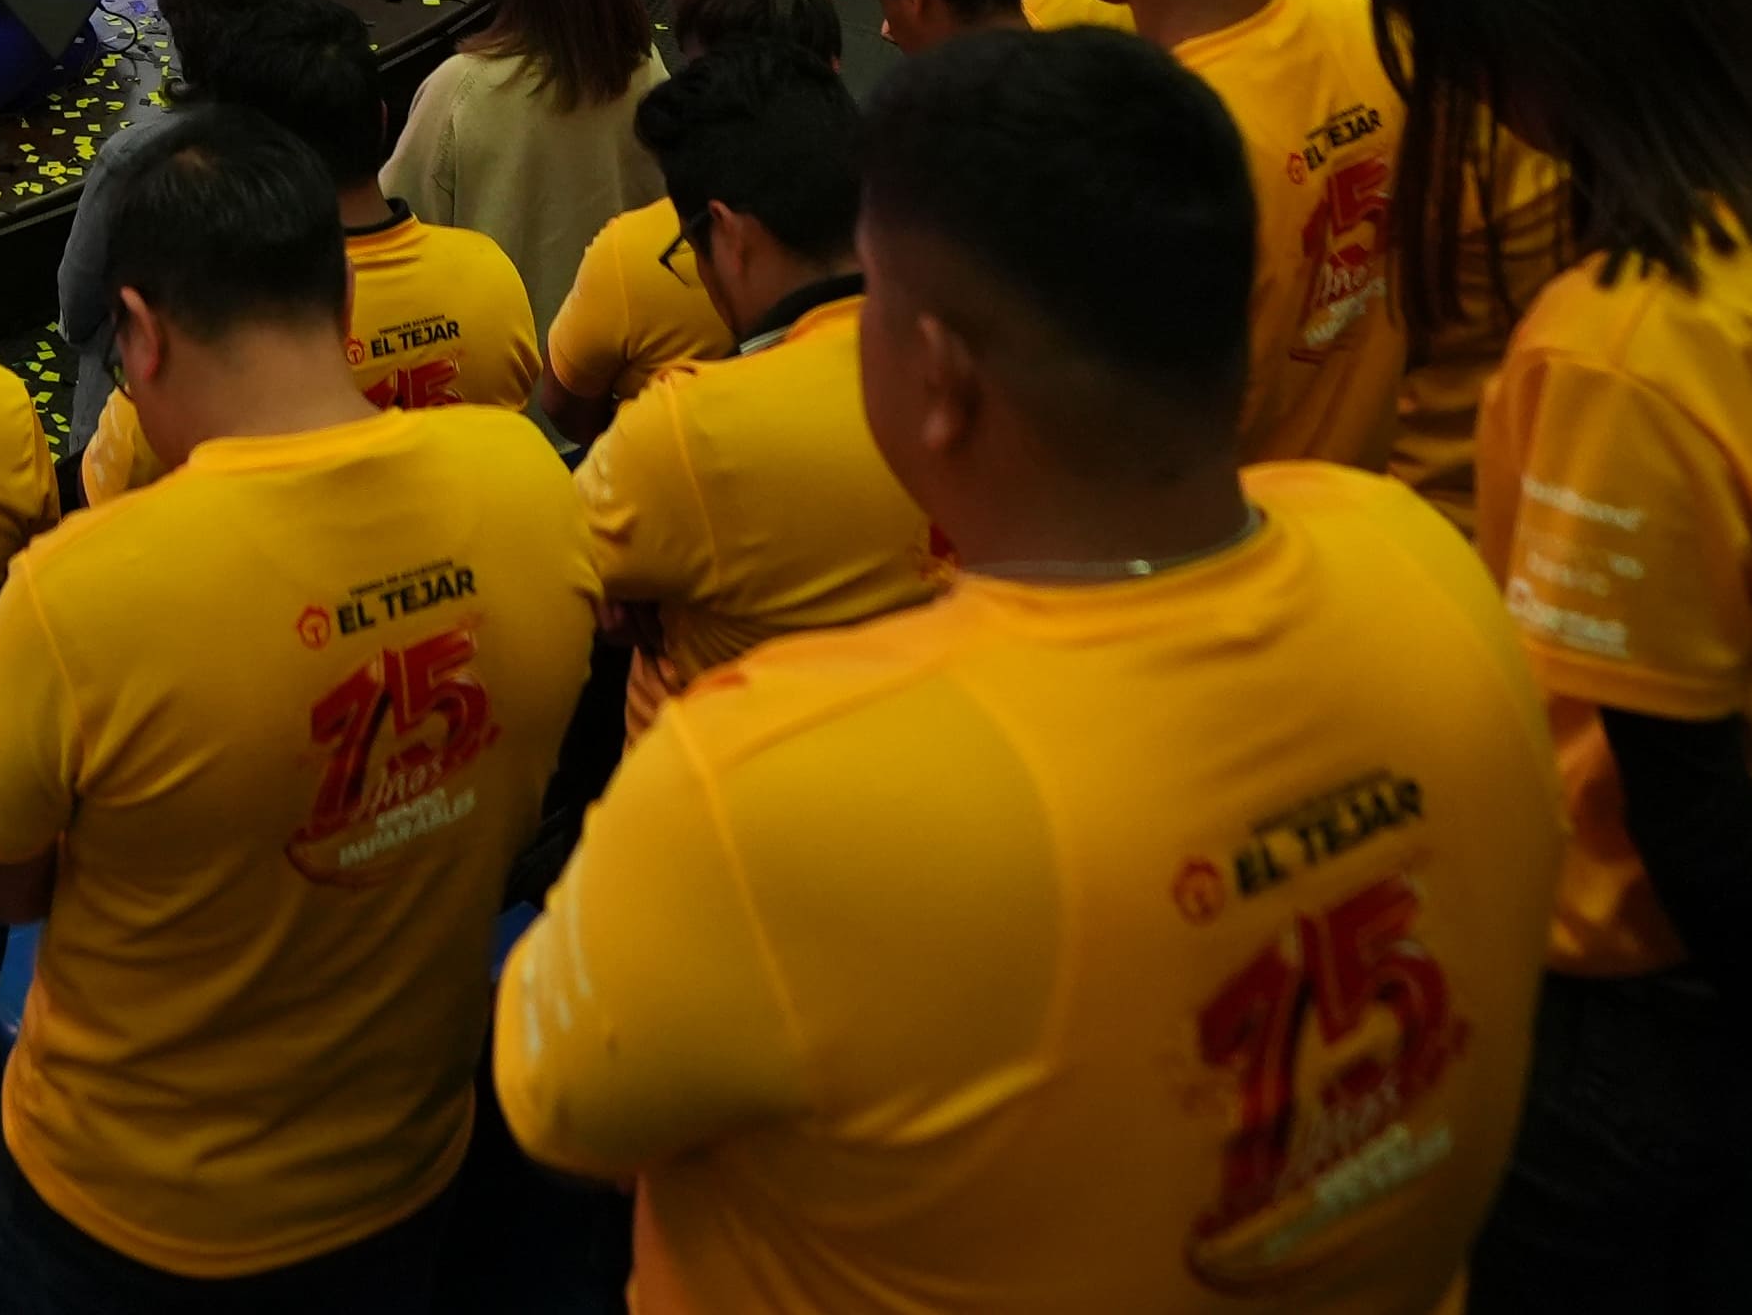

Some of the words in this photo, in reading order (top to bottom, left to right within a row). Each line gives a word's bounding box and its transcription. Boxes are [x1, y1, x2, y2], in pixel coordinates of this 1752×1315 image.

[1327, 108, 1383, 148] EJAR
[370, 336, 396, 359] EL
[398, 320, 461, 351] TEJAR
[336, 602, 376, 637] EL
[380, 567, 479, 623] TEJAR
[310, 627, 492, 837] 75
[1234, 846, 1293, 899] EL
[1298, 777, 1425, 867] TEJAR
[1199, 876, 1450, 1226] 75
